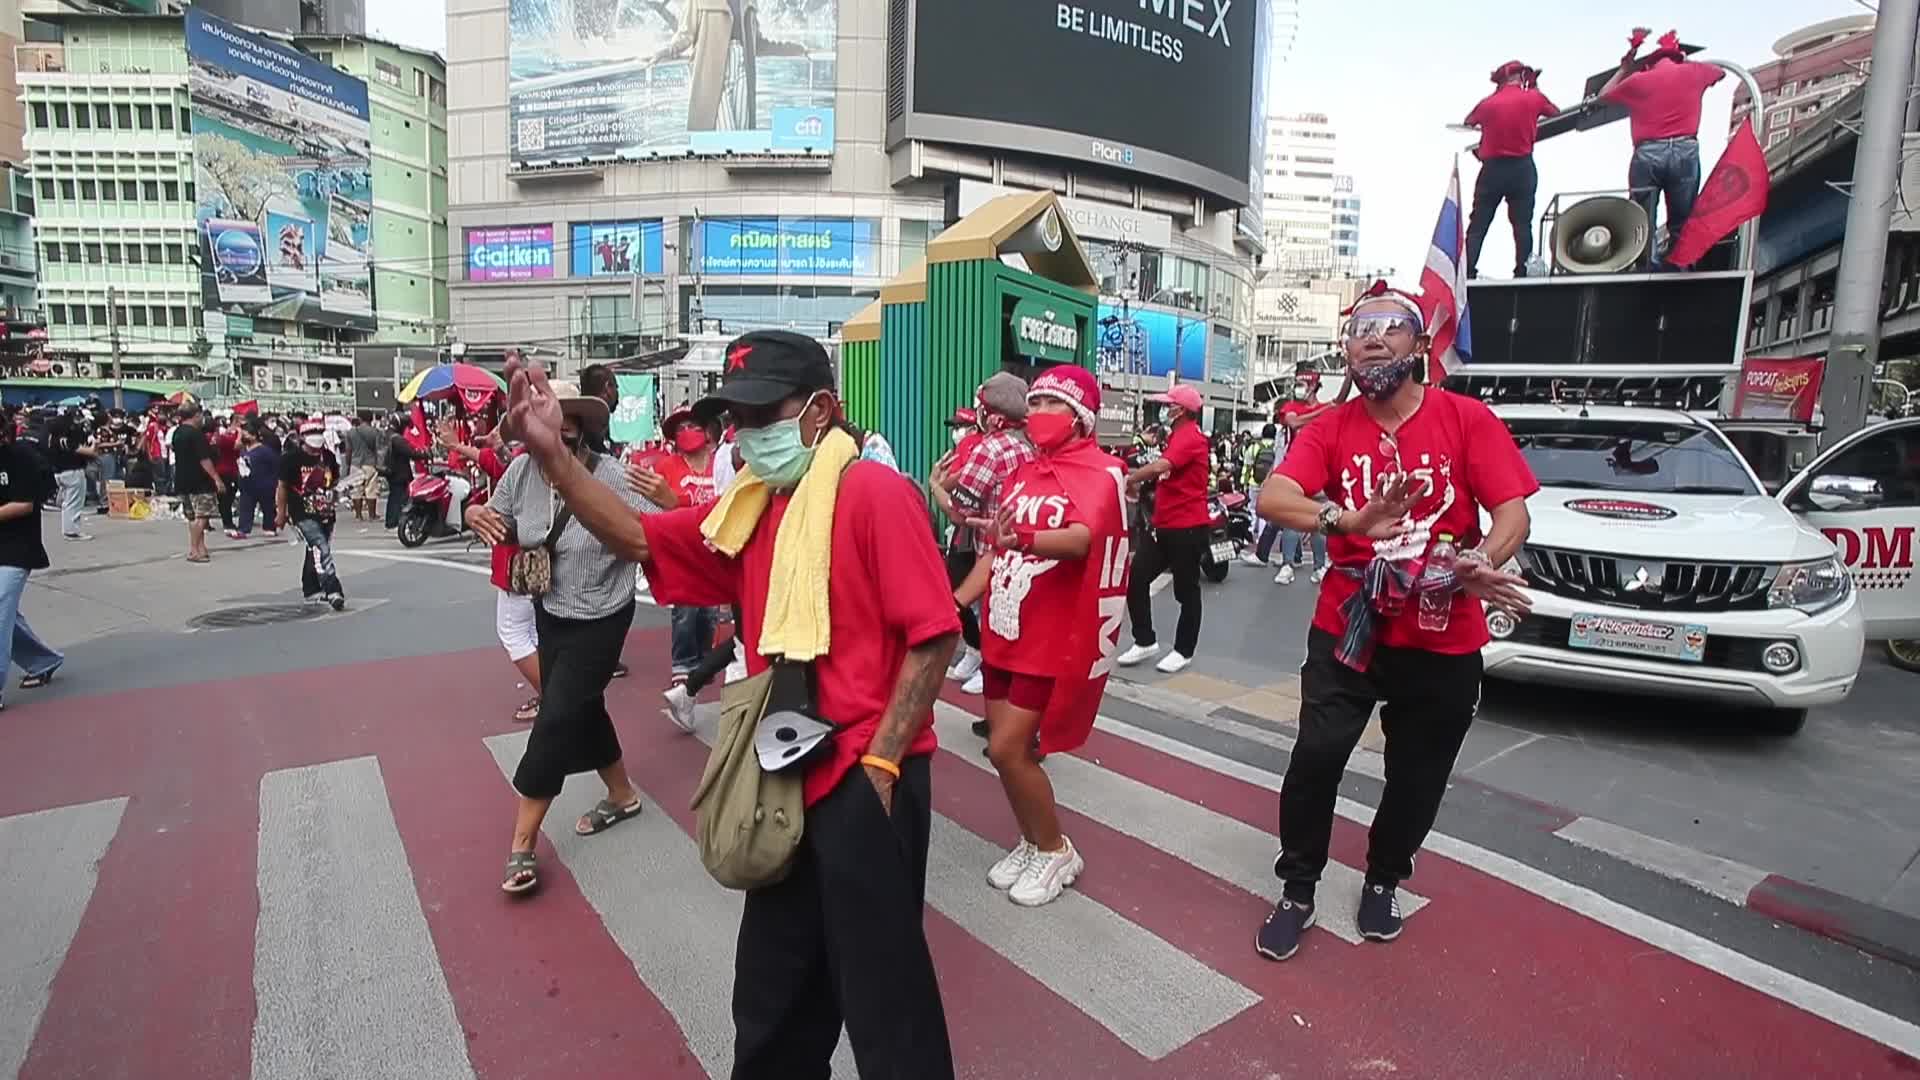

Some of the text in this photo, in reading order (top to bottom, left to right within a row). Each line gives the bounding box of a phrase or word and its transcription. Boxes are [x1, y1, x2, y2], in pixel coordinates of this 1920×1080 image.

[1057, 3, 1183, 63] BE LIMITLESS
[1092, 141, 1121, 162] Plan
[474, 244, 550, 267] Gakken
[1746, 370, 1778, 387] POPCAT
